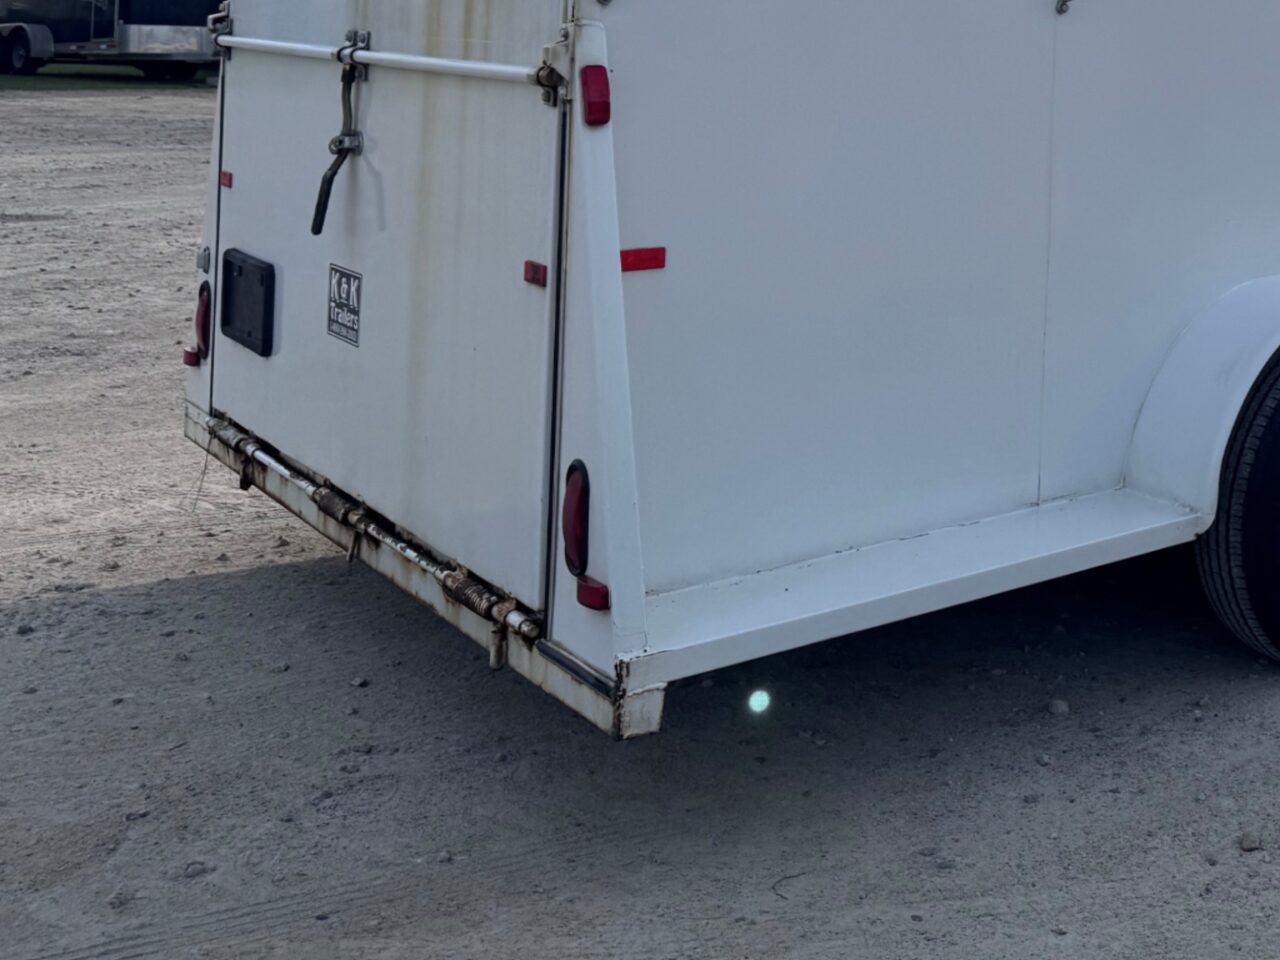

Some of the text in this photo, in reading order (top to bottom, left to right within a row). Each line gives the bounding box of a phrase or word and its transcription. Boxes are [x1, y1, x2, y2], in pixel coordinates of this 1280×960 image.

[330, 269, 359, 311] K & K
[330, 301, 359, 330] Trailers
